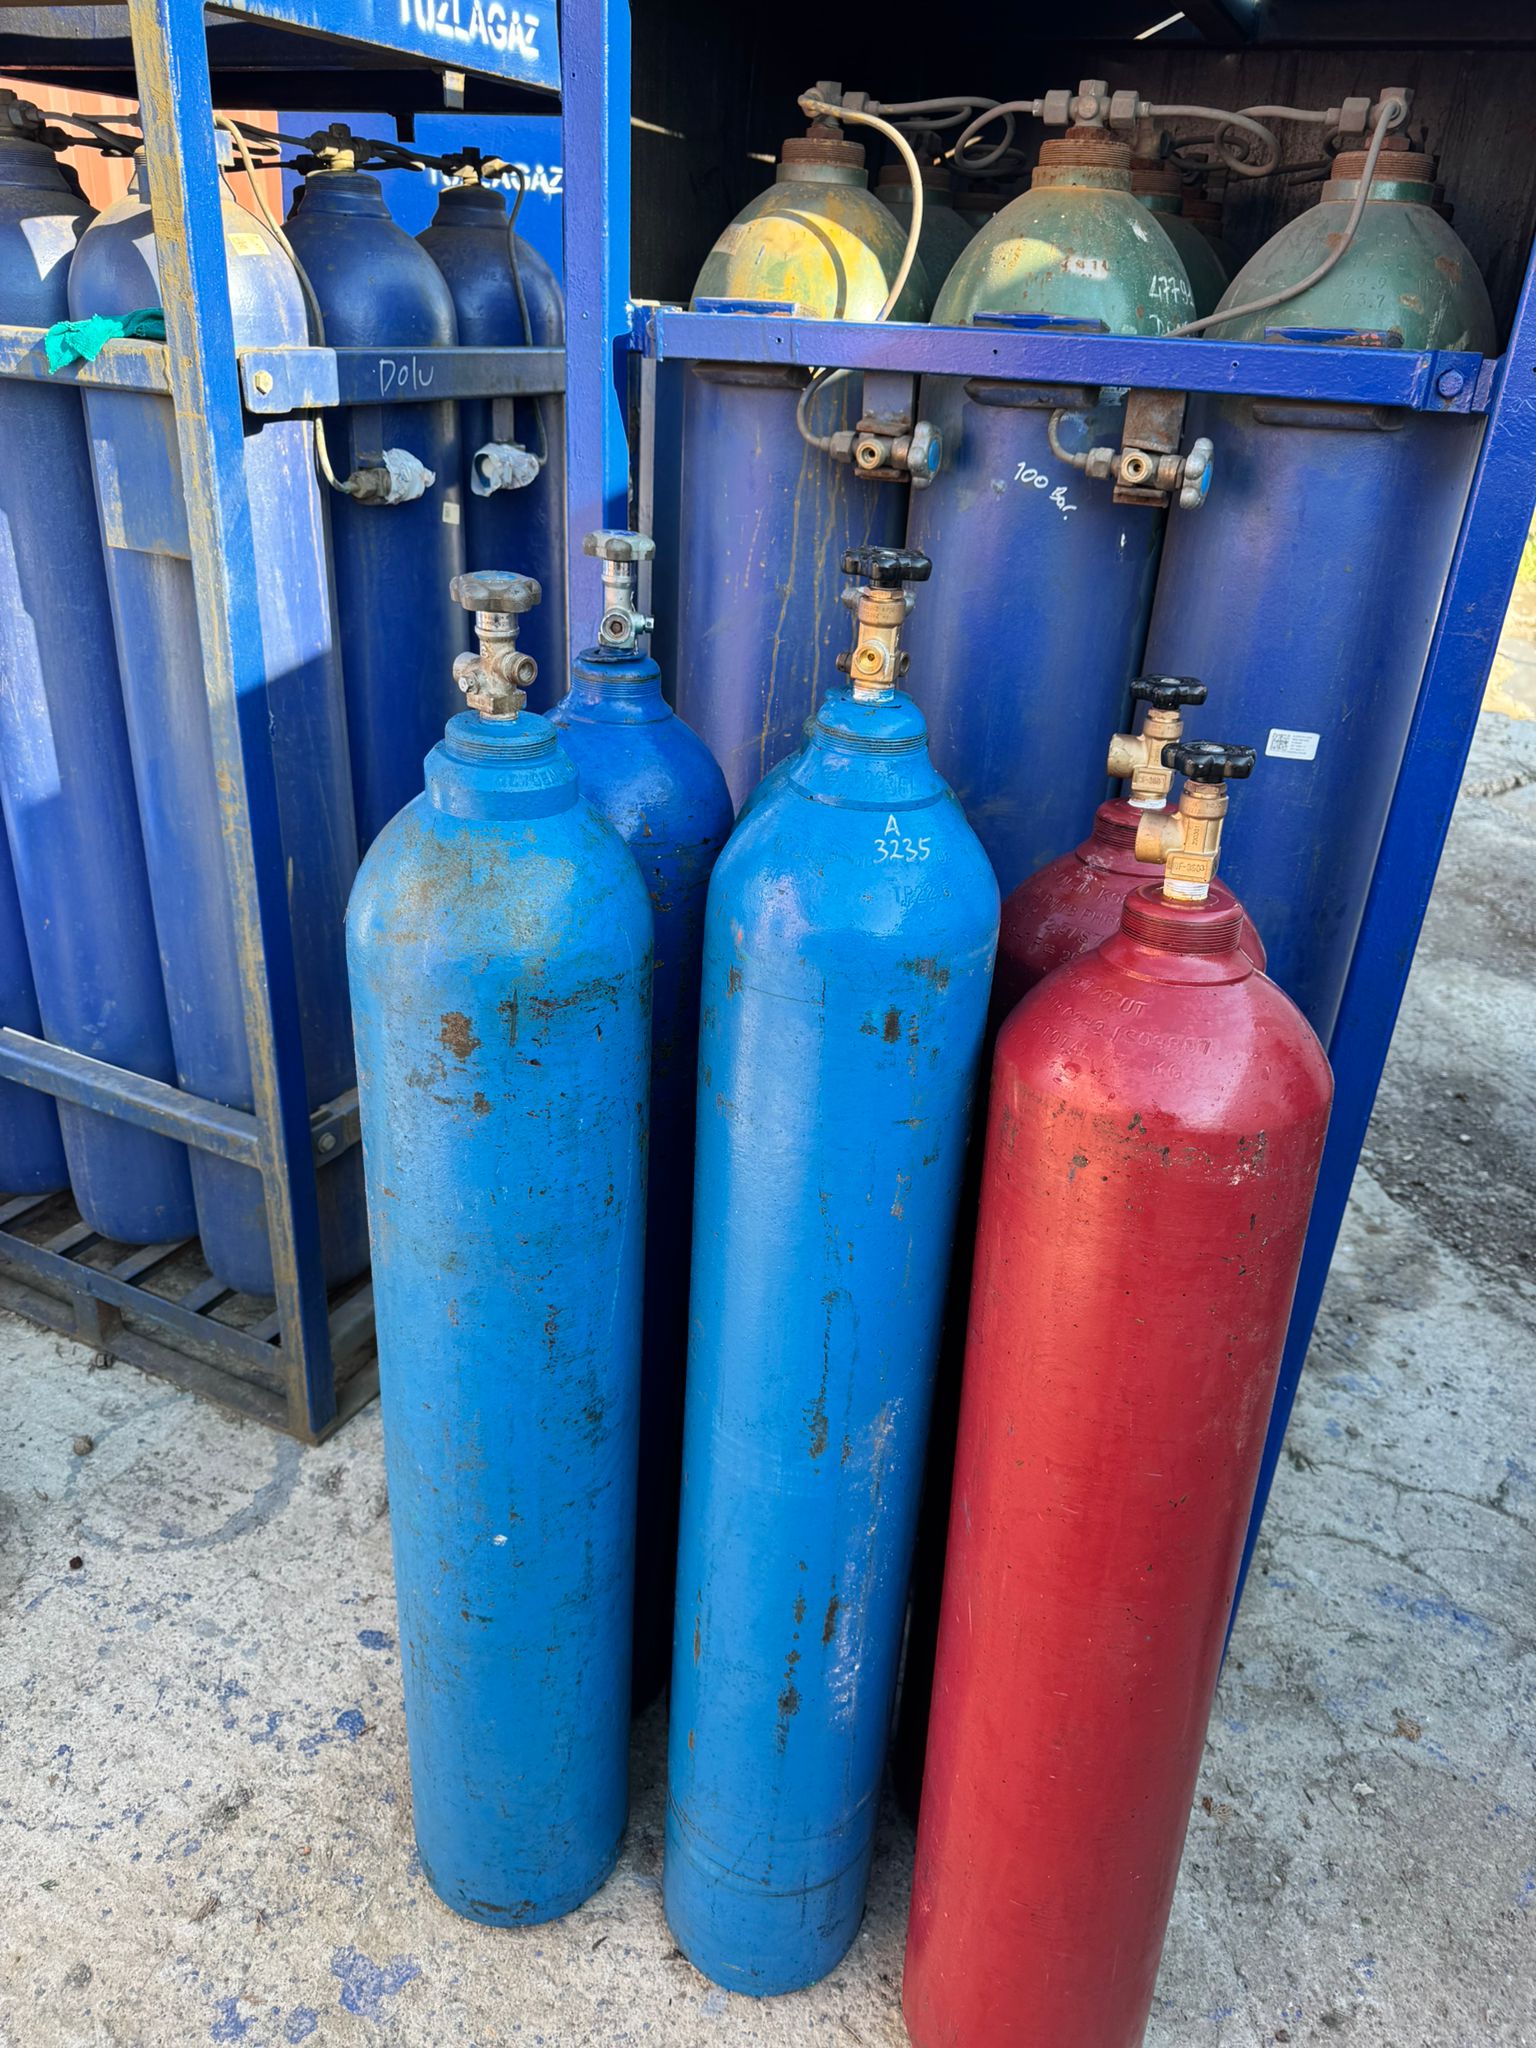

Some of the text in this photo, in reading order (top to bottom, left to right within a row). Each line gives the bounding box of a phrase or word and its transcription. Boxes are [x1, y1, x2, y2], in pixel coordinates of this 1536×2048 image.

[379, 356, 434, 397] Dolu
[1014, 461, 1049, 489] 100
[884, 814, 900, 836] A
[873, 837, 931, 864] 3235
